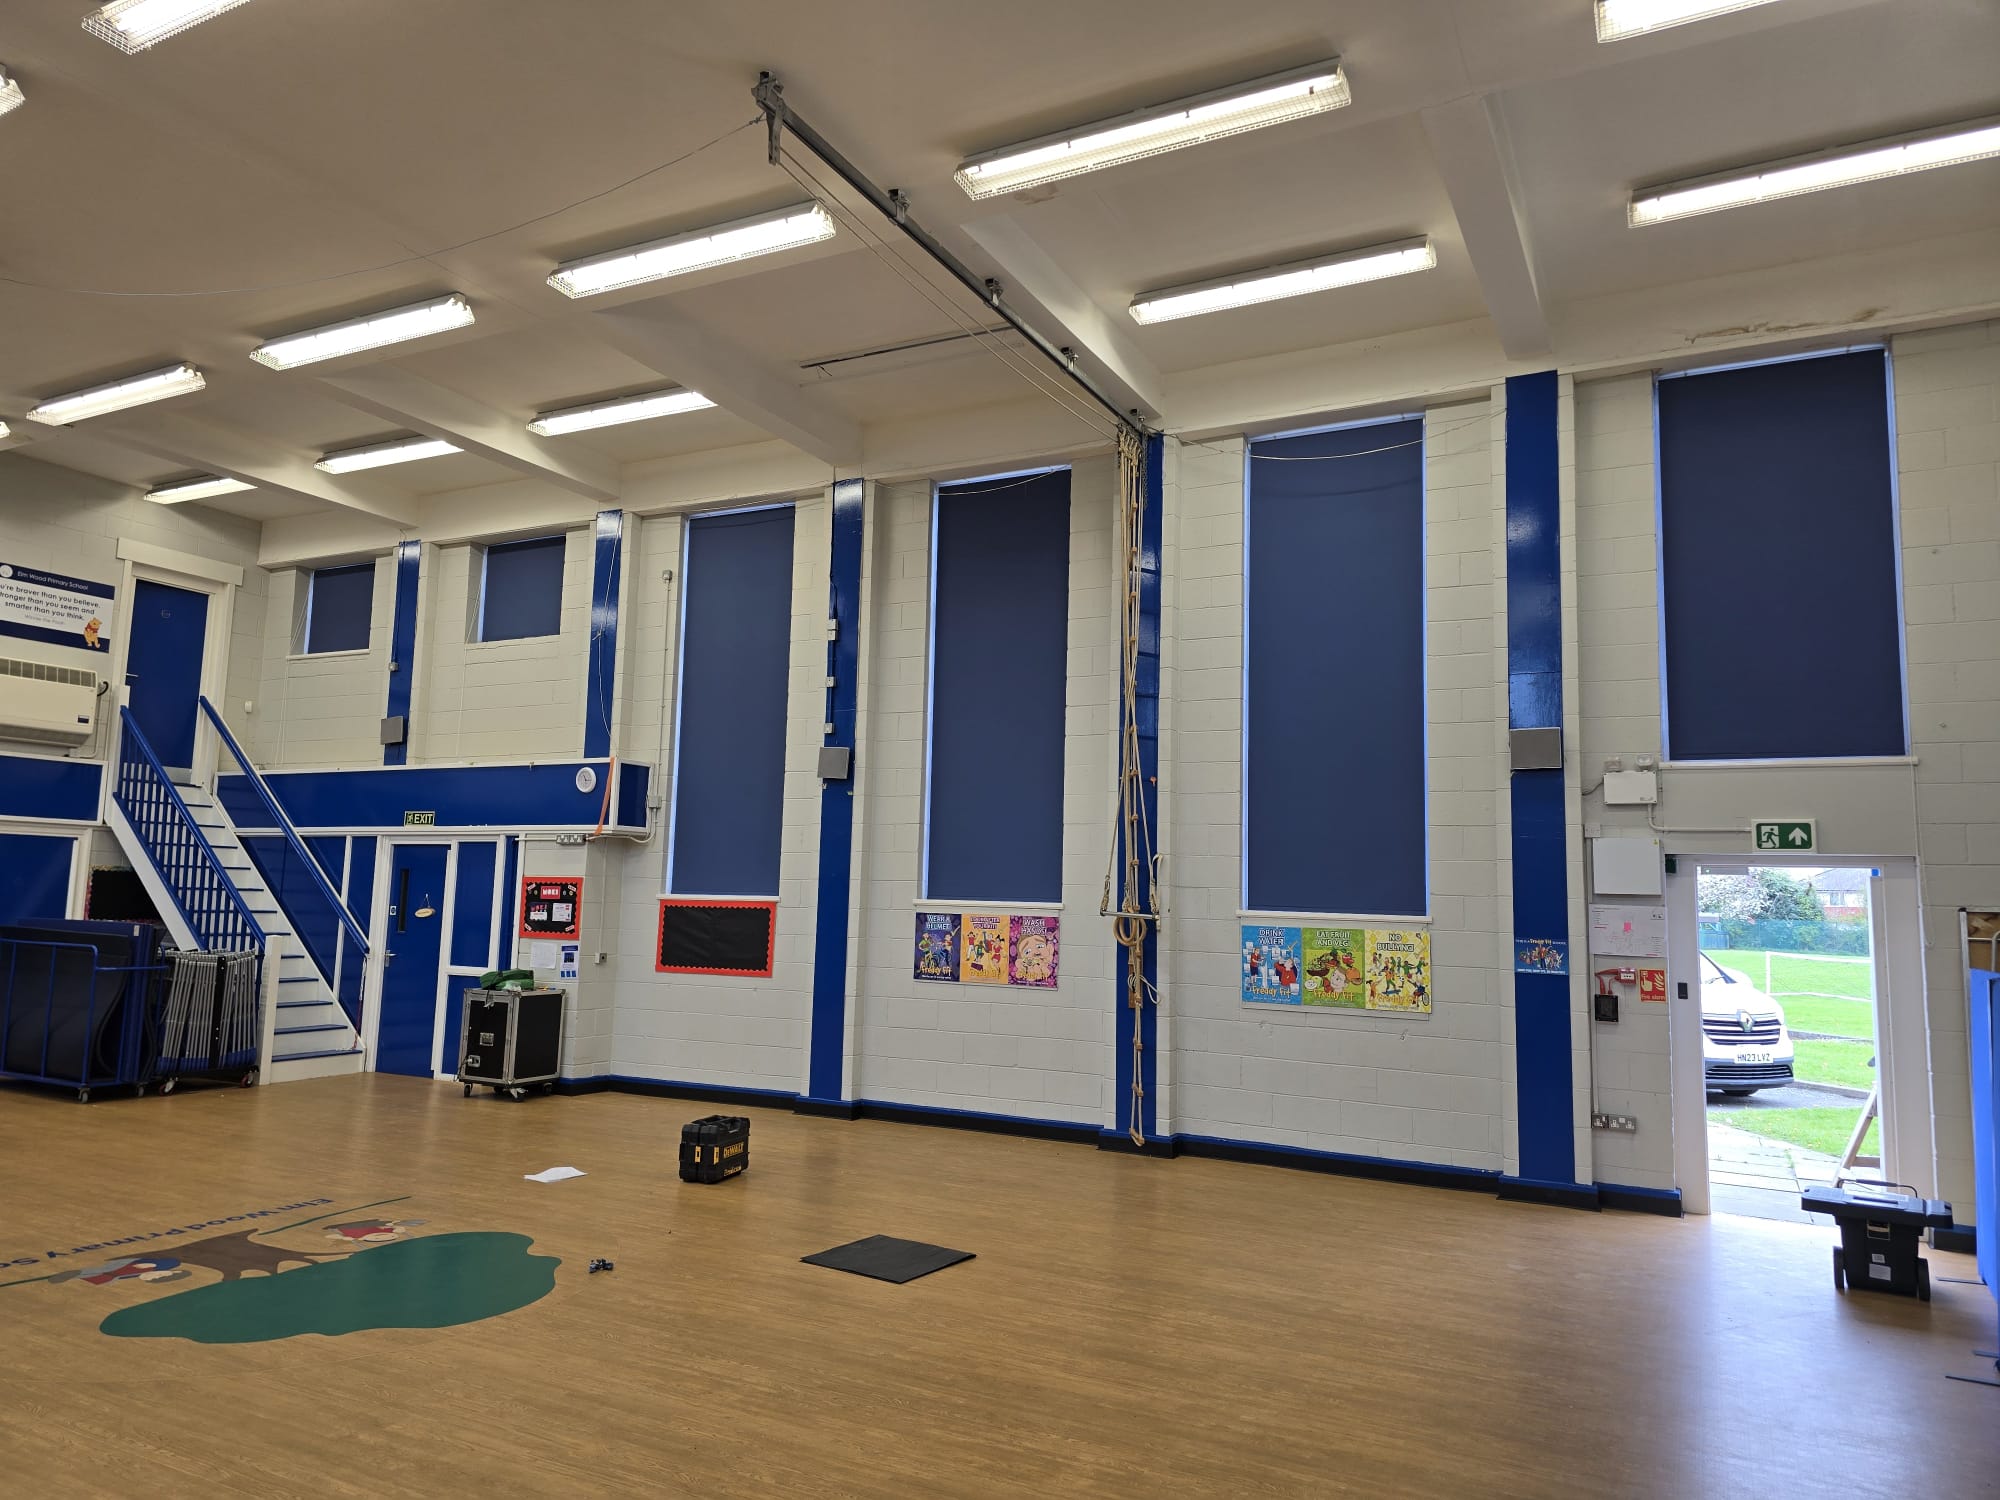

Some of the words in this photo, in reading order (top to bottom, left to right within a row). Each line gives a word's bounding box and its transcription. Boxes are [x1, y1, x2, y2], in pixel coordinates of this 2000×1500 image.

[29, 573, 47, 582] Wood
[47, 577, 68, 587] Primary
[69, 581, 89, 590] School
[15, 586, 40, 596] braver
[41, 591, 57, 600] than
[4, 601, 33, 611] smarter
[34, 605, 50, 614] than
[27, 597, 43, 605] than
[60, 604, 80, 612] seem
[414, 814, 433, 824] EXIT
[1024, 919, 1045, 927] WASH
[1259, 929, 1284, 937] DRINK
[1316, 930, 1329, 938] EAT
[1389, 934, 1402, 942] NO
[1259, 937, 1284, 945] WATER
[1377, 943, 1414, 952] BULLYING
[1252, 985, 1277, 998] Freddy
[1313, 989, 1340, 1001] Freddy
[1737, 1053, 1756, 1062] HN23
[276, 1198, 335, 1211] Elm
[184, 1210, 280, 1231] Wood
[46, 1228, 187, 1258] Primary
